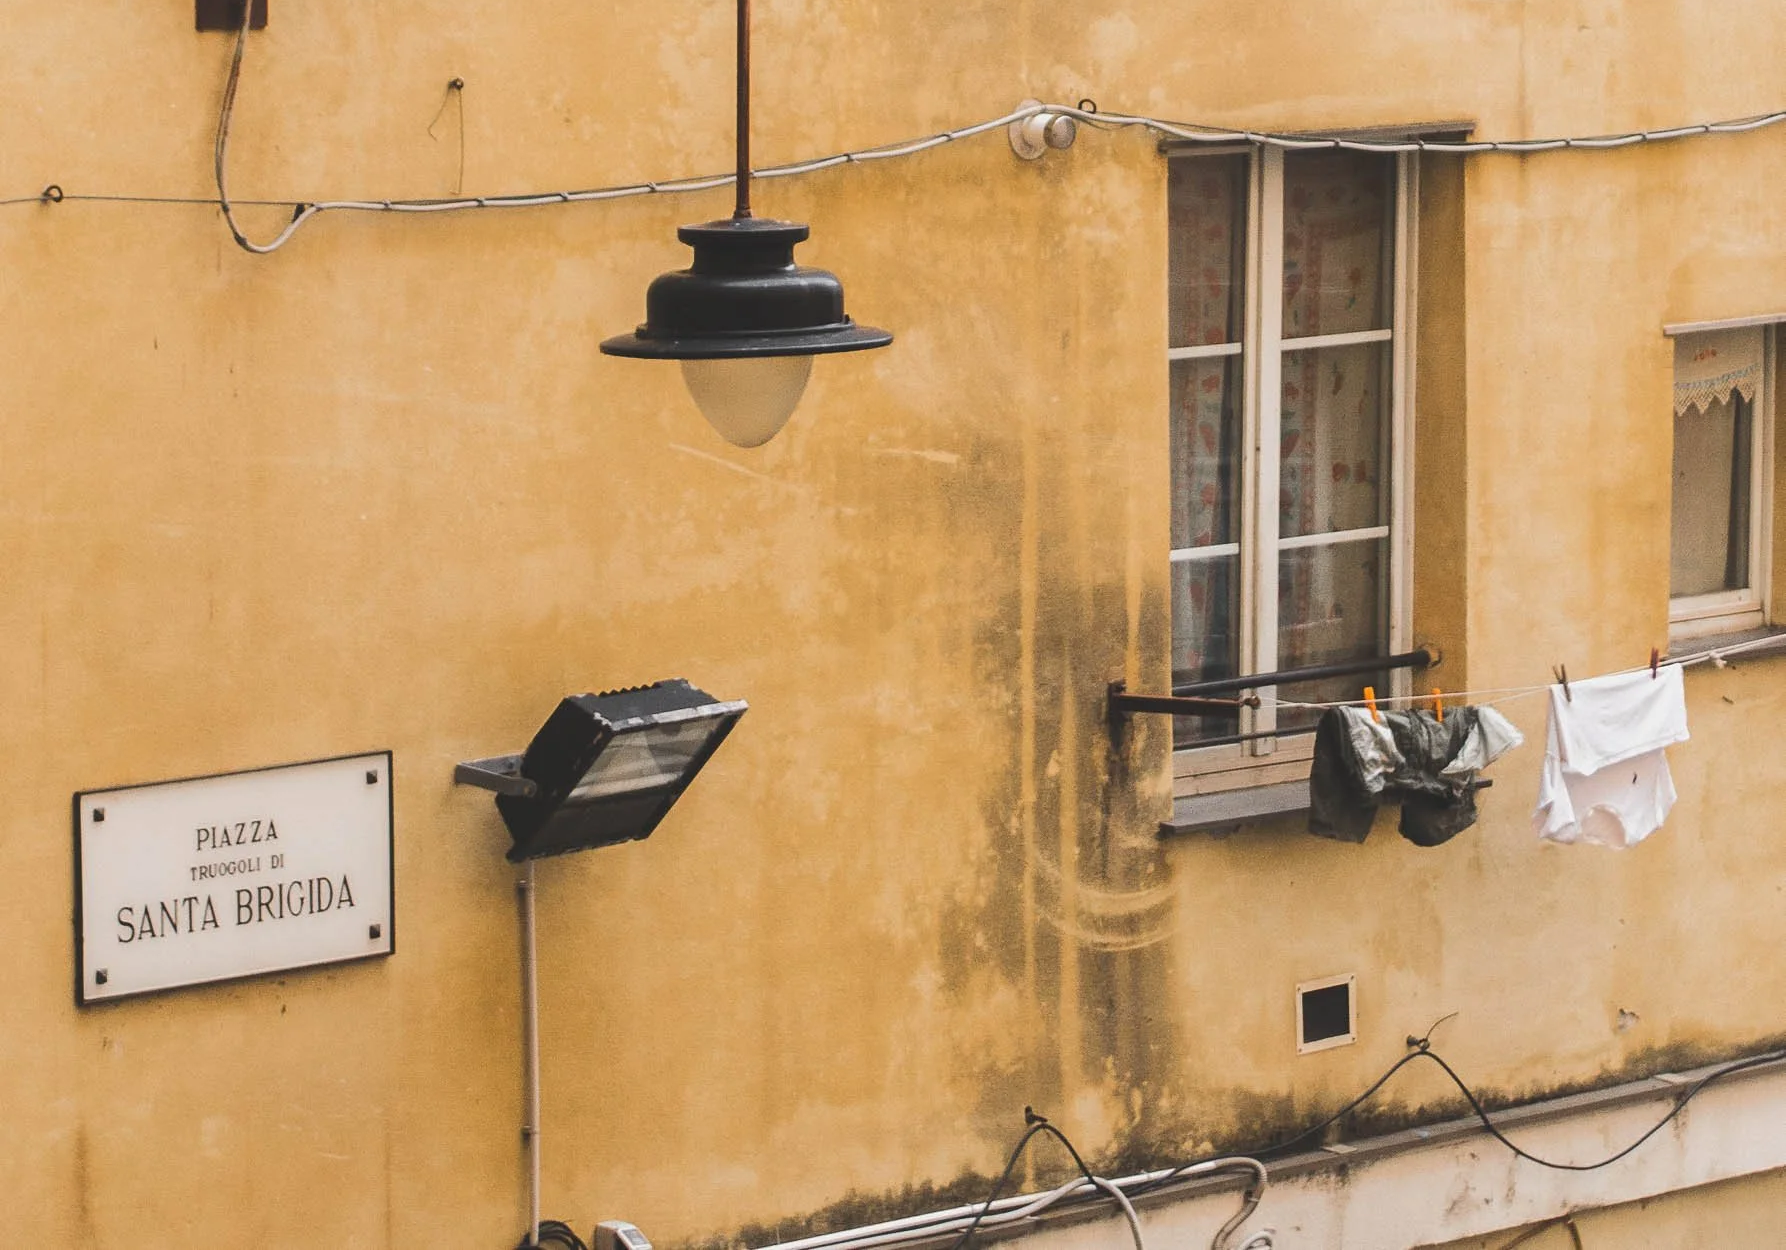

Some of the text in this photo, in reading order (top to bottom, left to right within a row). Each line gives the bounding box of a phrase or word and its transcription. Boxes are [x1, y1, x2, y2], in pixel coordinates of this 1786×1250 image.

[196, 819, 278, 851] PIAZZA
[190, 853, 285, 881] TRUOGOLI DI
[117, 874, 355, 944] SANTA BRIGIDA
